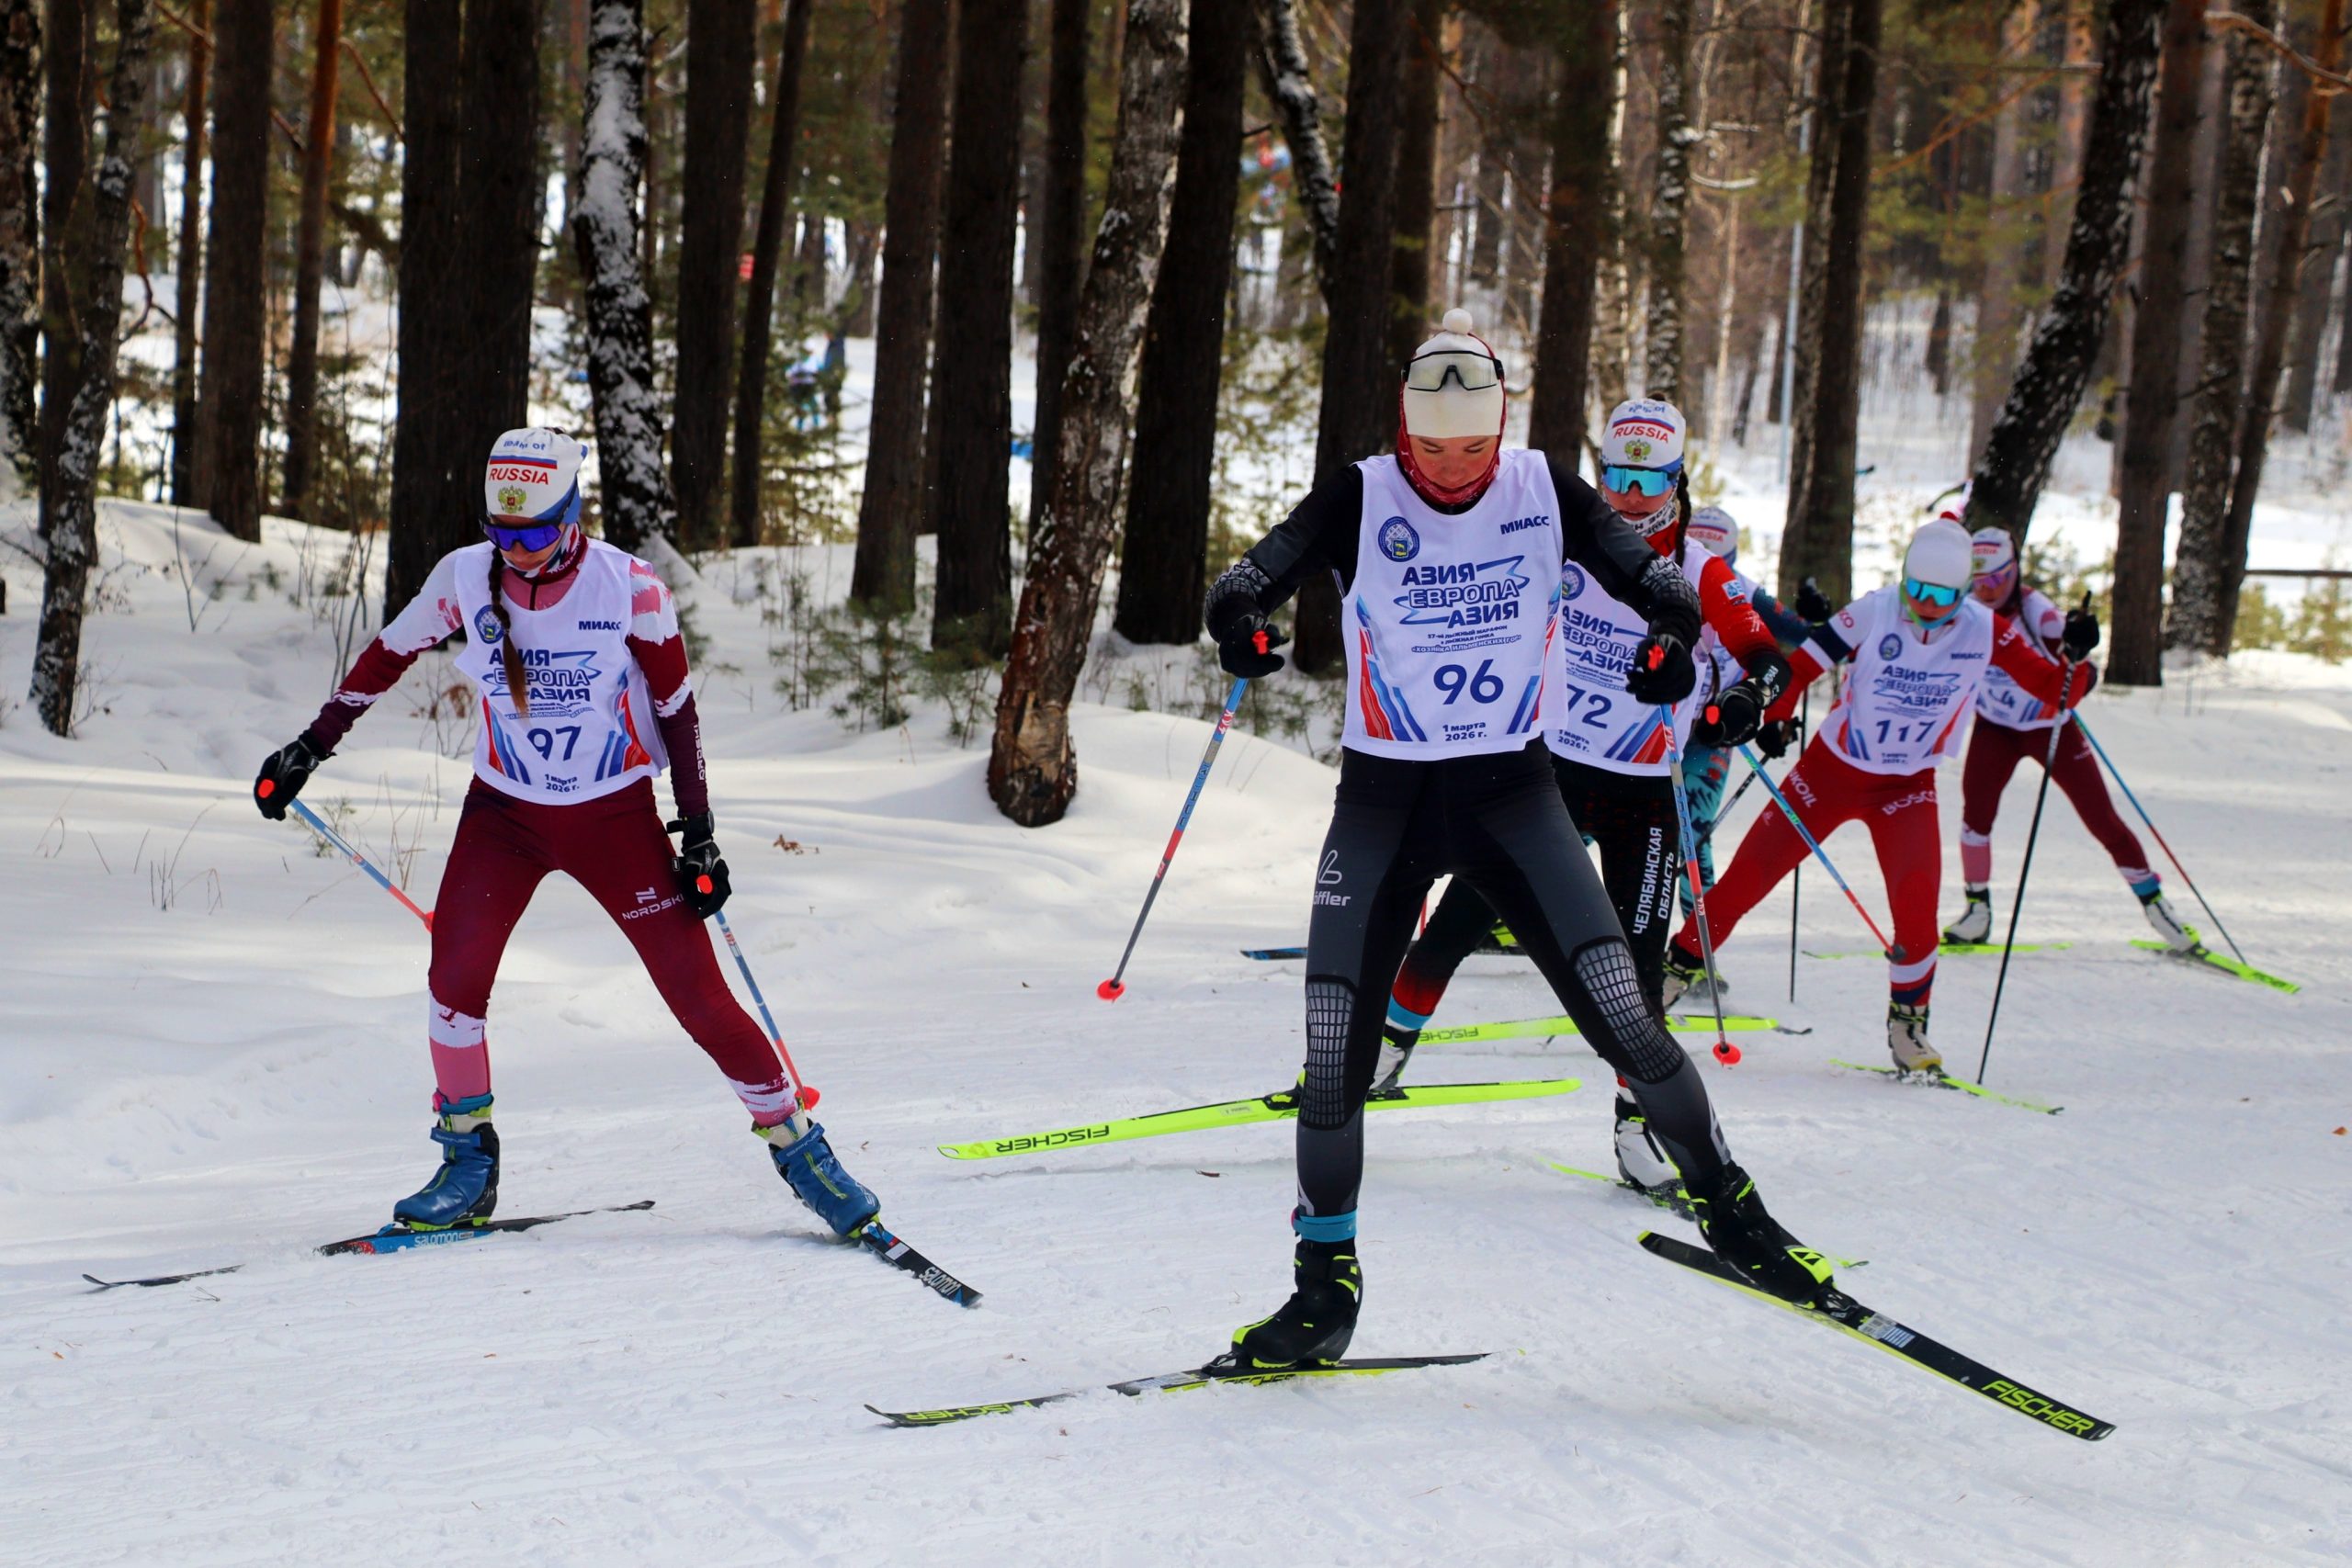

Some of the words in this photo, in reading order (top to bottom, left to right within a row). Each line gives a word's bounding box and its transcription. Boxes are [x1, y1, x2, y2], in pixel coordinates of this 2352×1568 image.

[1613, 426, 1668, 444] RUSSIA
[489, 468, 549, 485] RUSSIA
[1499, 515, 1550, 535] МИАСС
[1401, 562, 1476, 586] АЗИЯ
[1408, 579, 1521, 608] ЕВРОПА
[1447, 601, 1519, 628] АЗИЯ
[1562, 604, 1613, 637] АЗИЯ
[578, 620, 621, 631] МИАСС
[489, 648, 549, 667] АИЯ
[1578, 649, 1635, 675] АЗИЯ
[493, 668, 591, 687] ЕРОПА
[1433, 658, 1504, 705] 96
[1882, 665, 1928, 682] АЗИЯ
[530, 688, 591, 703] АЗИЯ
[1901, 695, 1950, 707] АЗИЯ
[1566, 682, 1612, 729] 72
[1442, 724, 1449, 733] 1
[1450, 722, 1487, 734] марта
[1444, 731, 1476, 742] 2026
[1564, 729, 1590, 745] марта
[1876, 719, 1937, 745] 117
[526, 725, 582, 761] 97
[1557, 736, 1581, 749] 2026
[546, 782, 571, 793] 2026
[550, 775, 578, 786] марта
[1788, 769, 1817, 808] KOIL
[1633, 827, 1663, 935] ЧЕЛЯБИНСКАЯ
[1657, 852, 1675, 919] ОБЛАСТЬ
[621, 893, 684, 920] NORDSKI
[1419, 1027, 1479, 1043] FISCHE
[995, 1124, 1110, 1153] FISCHER
[414, 1232, 458, 1247] salomon
[1981, 1380, 2095, 1436] FISCHER
